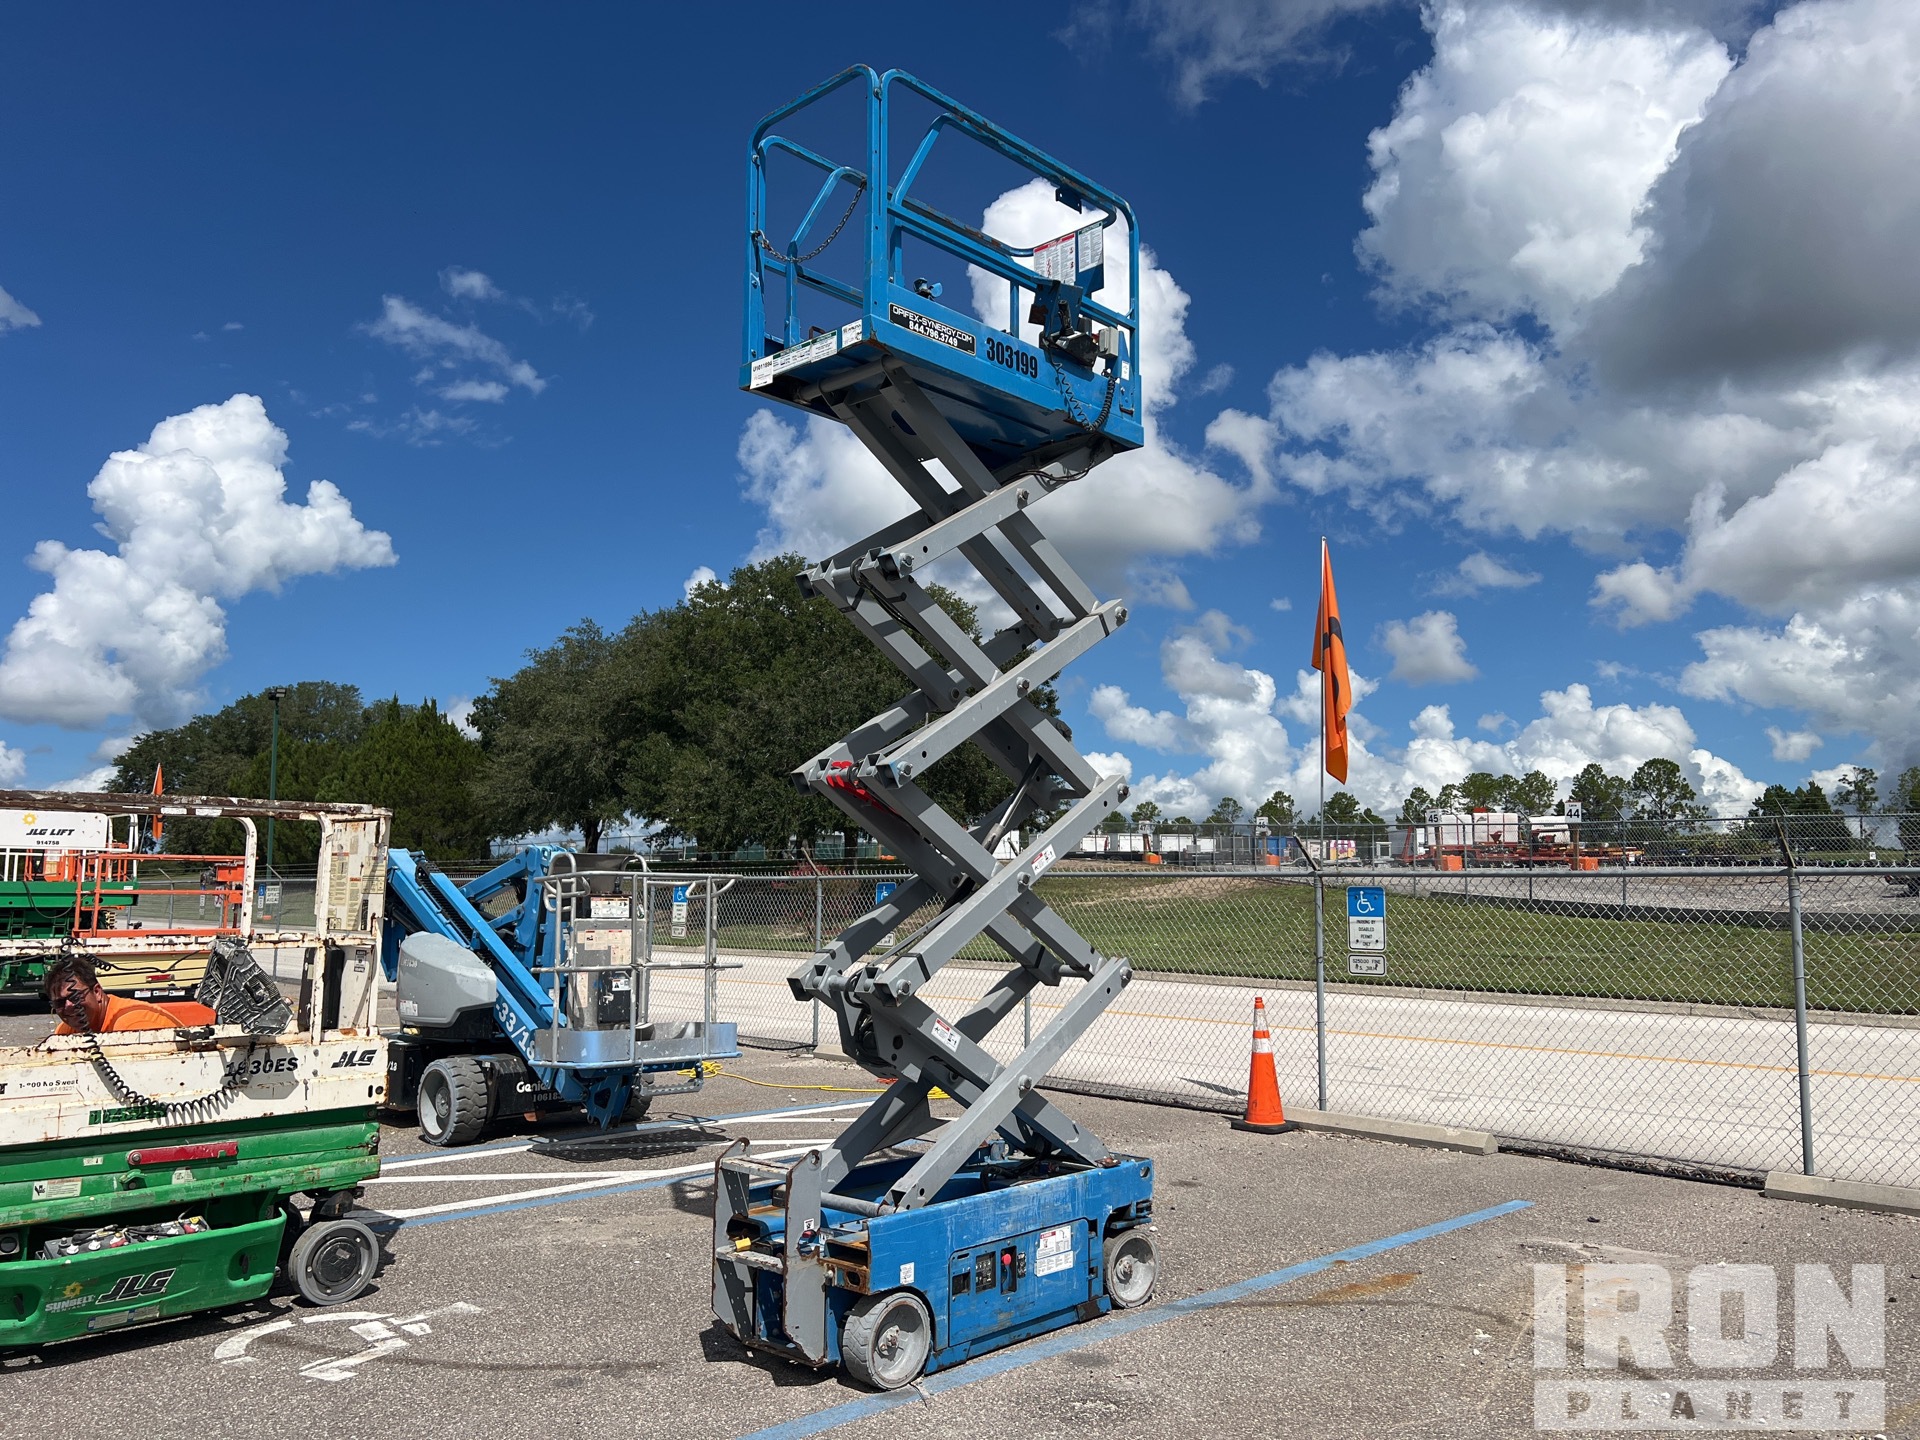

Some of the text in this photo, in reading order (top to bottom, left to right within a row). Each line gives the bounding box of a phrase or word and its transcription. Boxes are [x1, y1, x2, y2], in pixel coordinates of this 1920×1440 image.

[892, 306, 973, 343] OPIFEX-SYNERGY.COM
[908, 320, 958, 347] 844.796.3749
[986, 337, 1038, 379] 303199
[1428, 814, 1438, 823] 45
[1566, 808, 1580, 818] 44
[331, 1049, 378, 1069] JLG
[95, 1268, 177, 1305] JLG
[45, 1294, 96, 1312] SUNBELT
